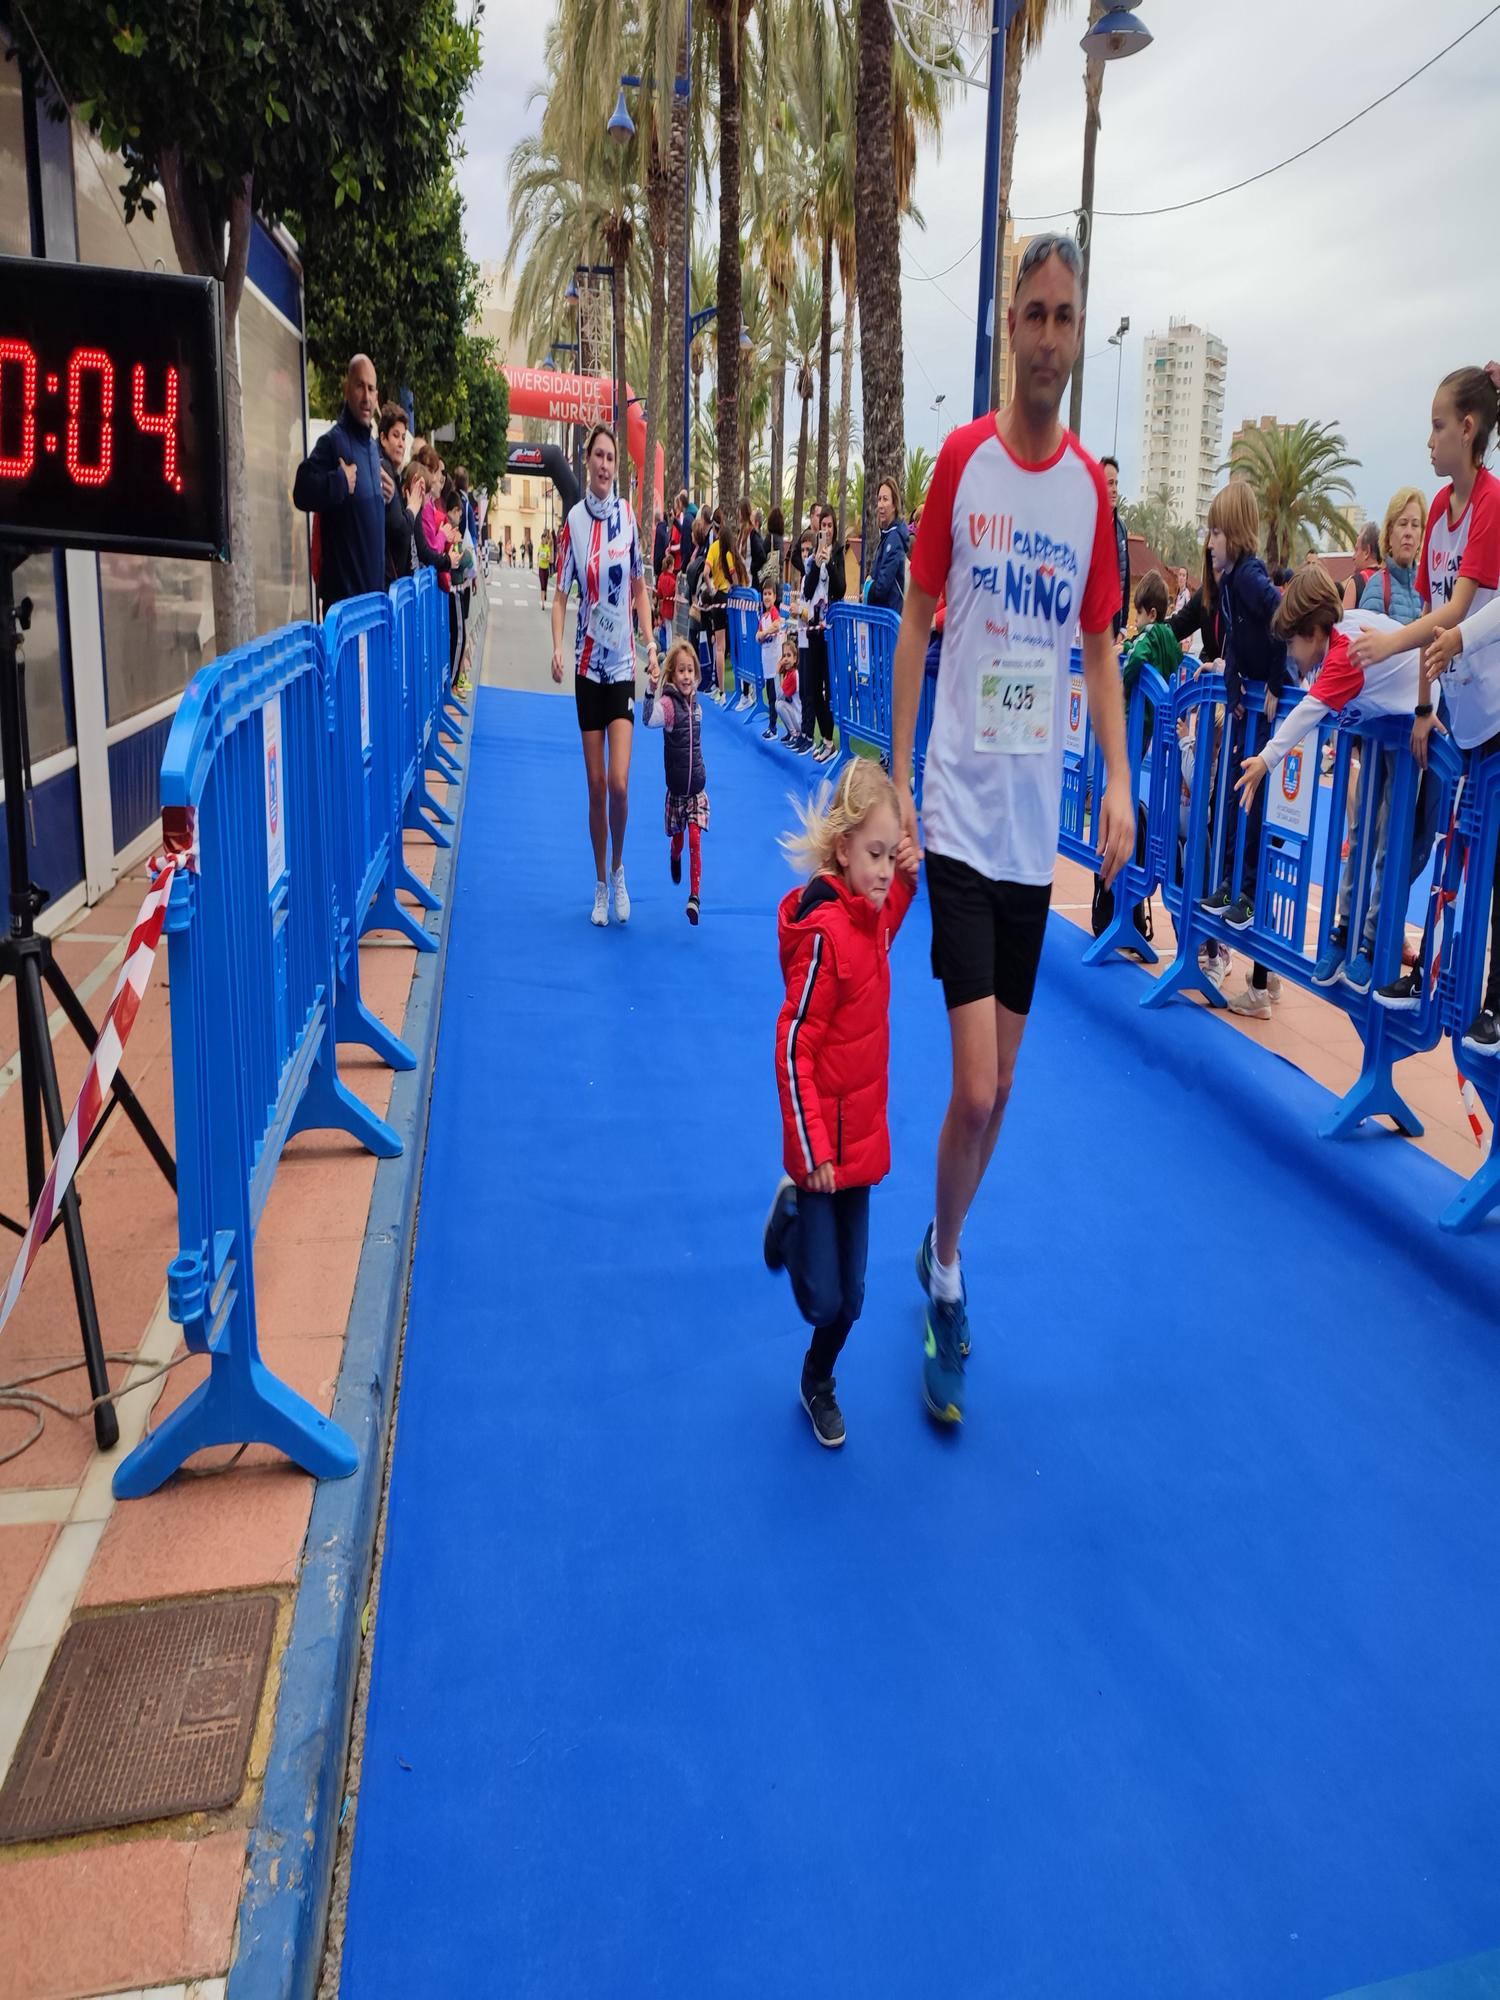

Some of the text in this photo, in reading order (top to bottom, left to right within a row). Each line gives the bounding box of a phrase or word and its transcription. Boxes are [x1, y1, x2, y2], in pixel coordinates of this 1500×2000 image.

[505, 369, 601, 398] NIVERSIDAD DE
[549, 400, 600, 421] MURCIA
[969, 513, 1077, 576] VIII CARRERA
[973, 566, 1001, 594] DEL
[1003, 685, 1035, 711] 435
